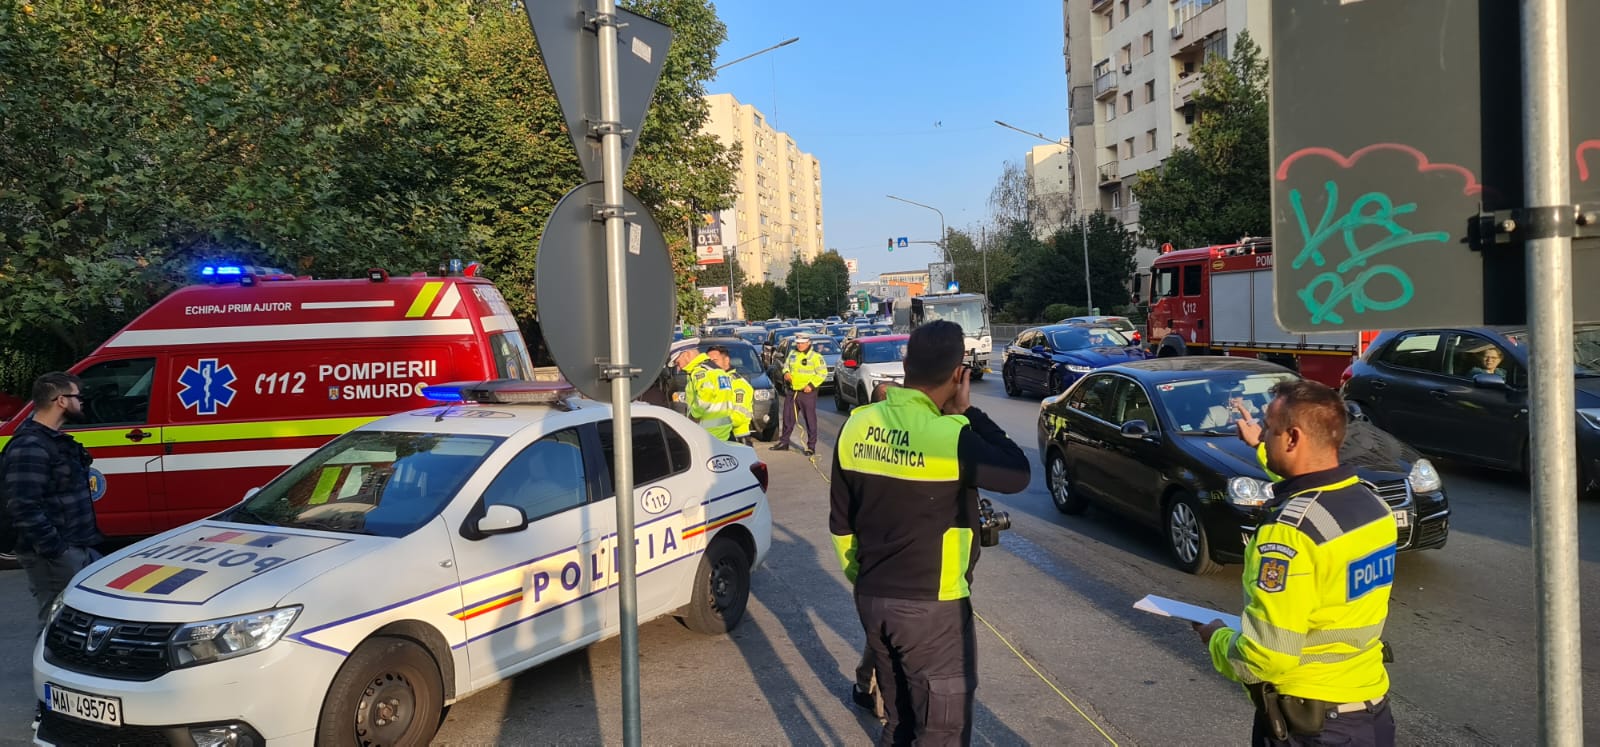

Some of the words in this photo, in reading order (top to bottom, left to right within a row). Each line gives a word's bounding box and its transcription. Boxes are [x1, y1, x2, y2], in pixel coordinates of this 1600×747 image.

[185, 304, 226, 316] ECHIPAJ
[227, 303, 252, 313] PRIM
[253, 302, 292, 312] AJUTOR
[1186, 303, 1197, 313] 112
[318, 359, 437, 382] POMPIERII
[265, 372, 307, 395] 112
[342, 383, 413, 400] SMURD
[865, 426, 910, 447] POLITIA
[853, 442, 925, 468] CRIMINALISTICA
[651, 494, 667, 510] 112
[533, 526, 677, 602] POLIIA
[51, 688, 71, 713] MAI
[76, 696, 117, 722] 49579
